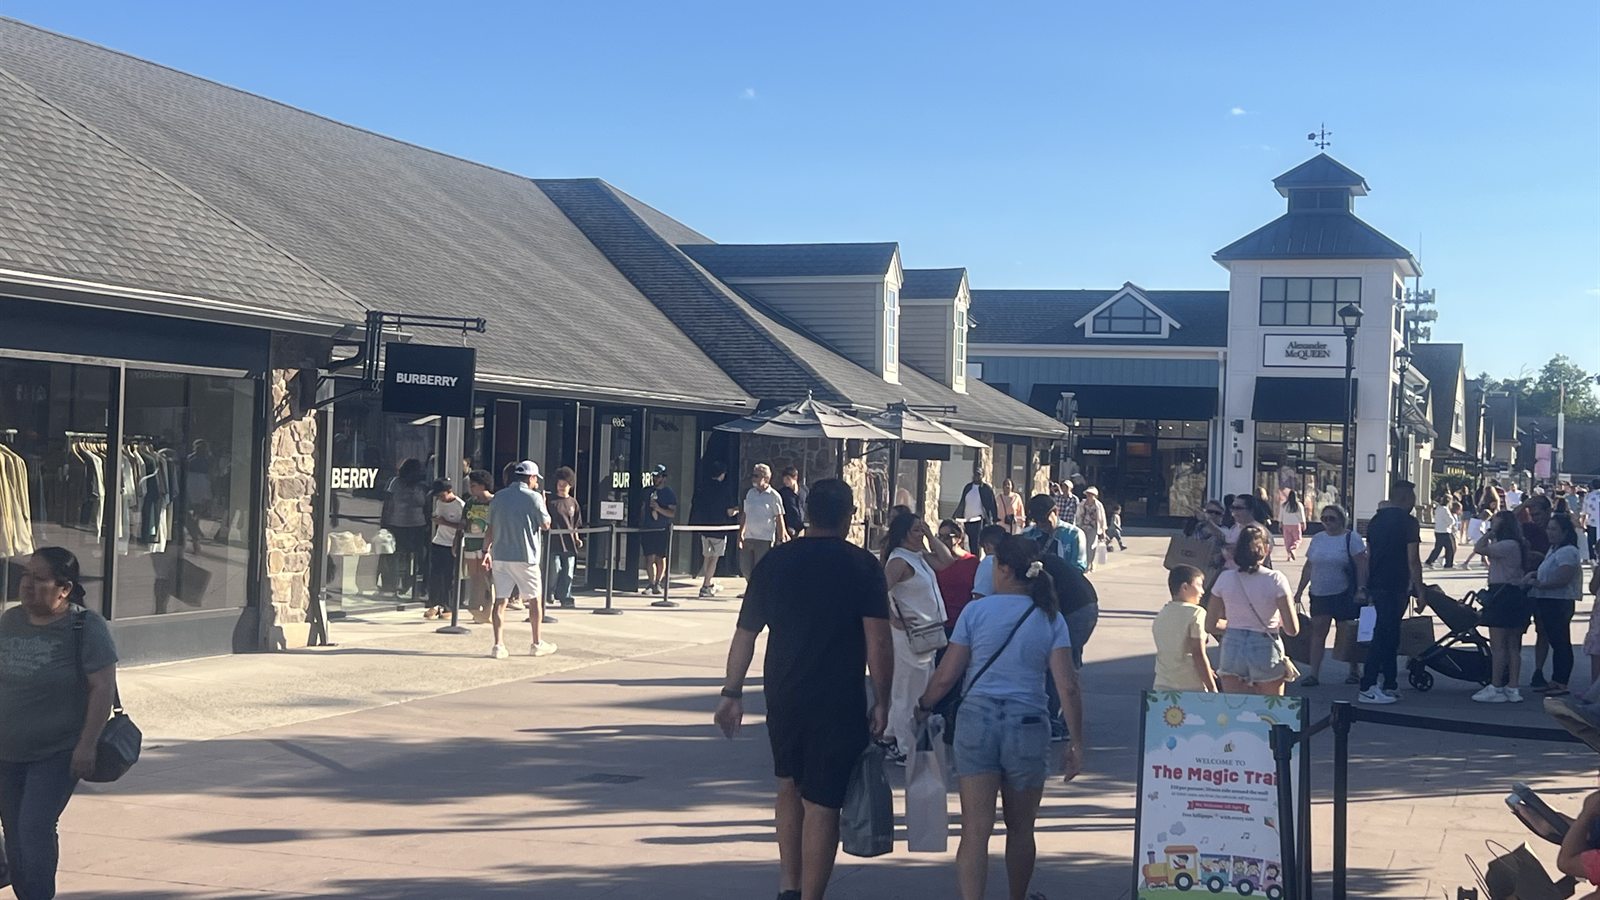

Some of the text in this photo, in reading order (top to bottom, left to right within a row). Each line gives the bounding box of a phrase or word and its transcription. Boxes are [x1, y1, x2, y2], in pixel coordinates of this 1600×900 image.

[1287, 341, 1327, 350] Alexander
[1285, 349, 1331, 360] McQUEEN
[396, 372, 458, 387] BURBERRY
[331, 467, 379, 489] BERRY
[1195, 757, 1246, 767] WELCOME TO
[1152, 765, 1278, 786] The Magic Trai
